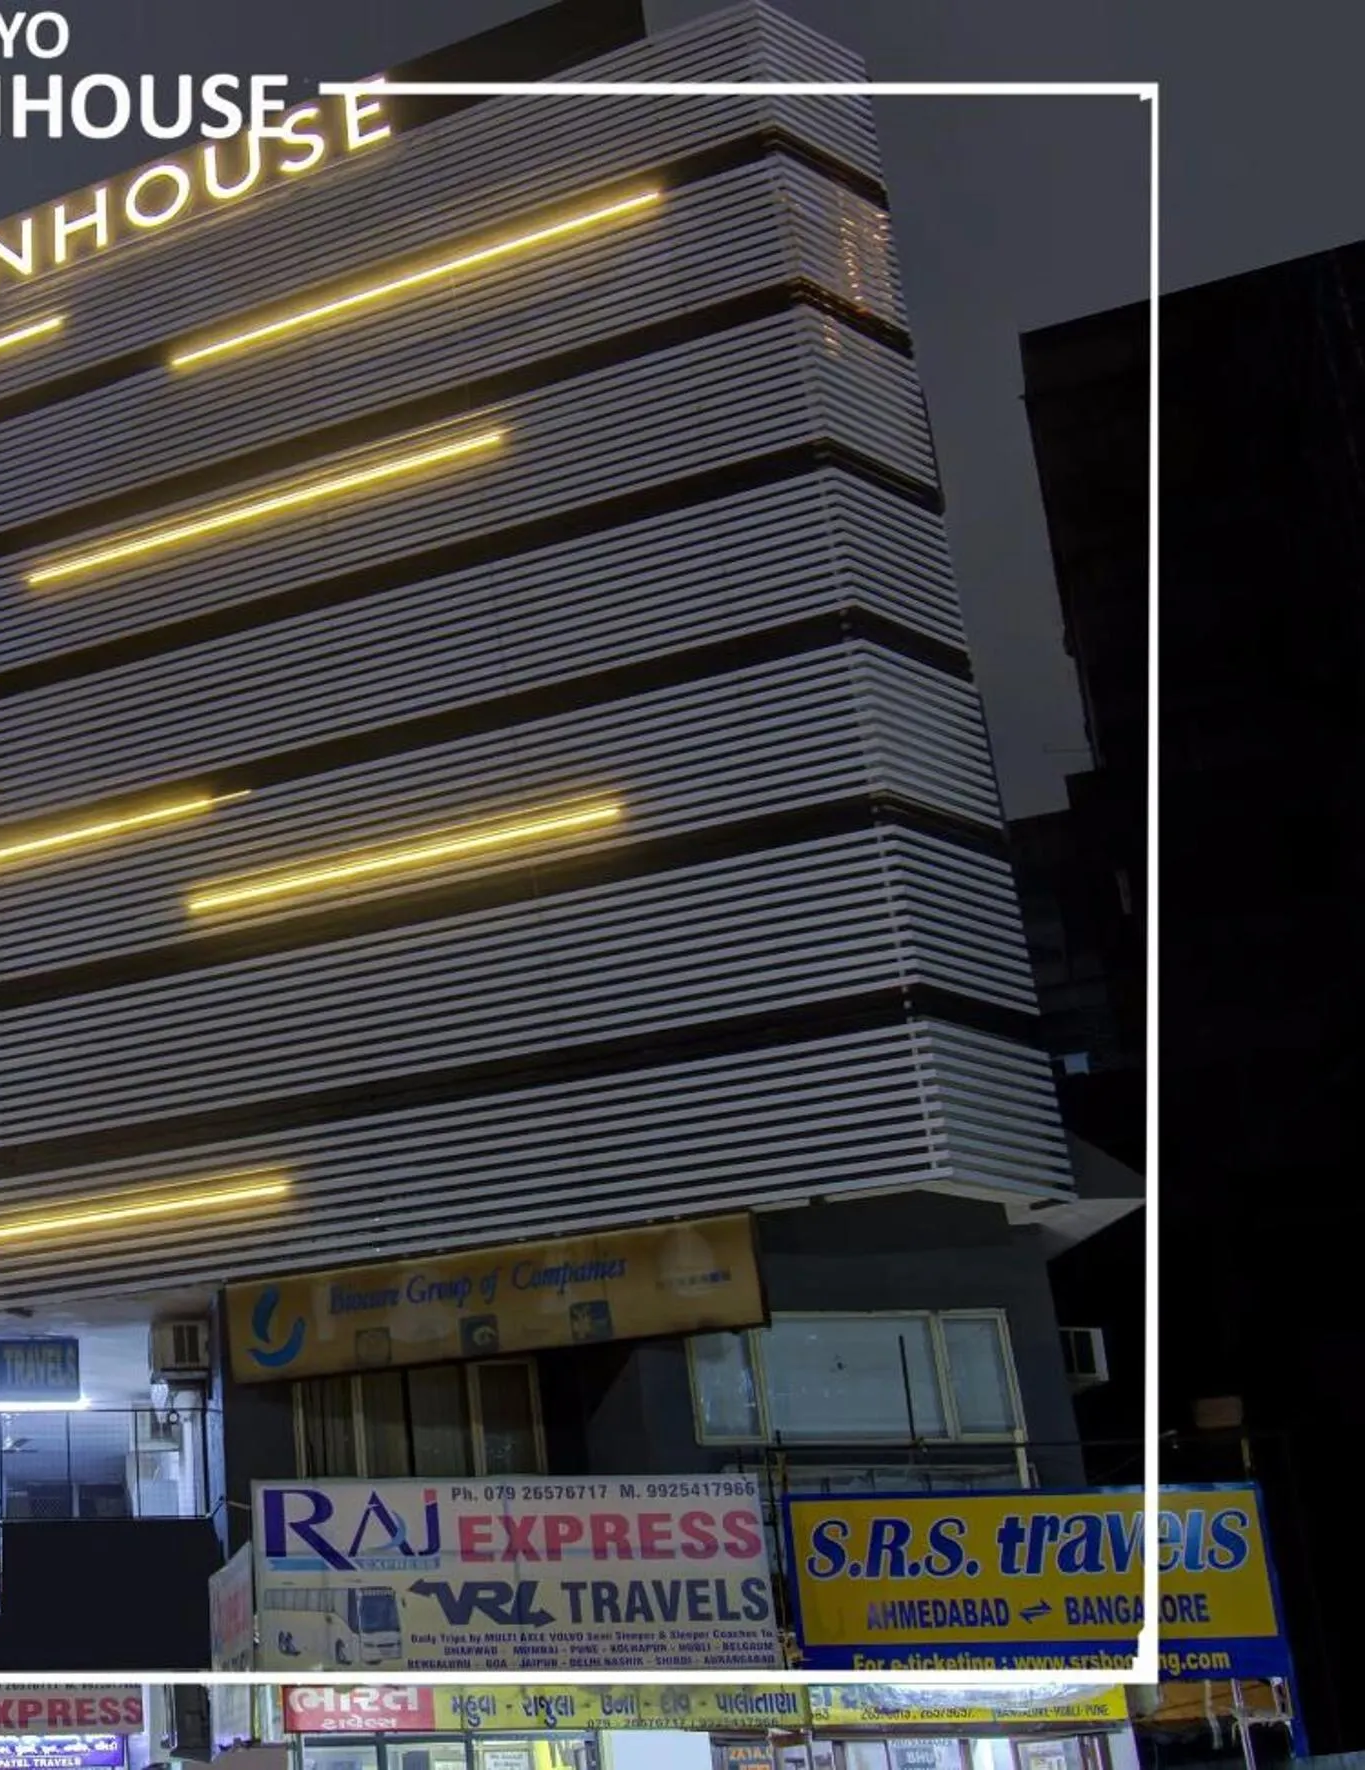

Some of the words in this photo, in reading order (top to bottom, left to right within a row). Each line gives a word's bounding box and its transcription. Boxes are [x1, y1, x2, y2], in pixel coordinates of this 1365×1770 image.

[451, 1486, 478, 1501] Ph.
[484, 1486, 516, 1500] 079
[620, 1484, 640, 1499] M.
[458, 1510, 762, 1562] EXPRESS
[806, 1516, 981, 1582] S.R.S.
[996, 1508, 1251, 1578] travels
[560, 1576, 770, 1625] TRAVELS
[867, 1598, 1010, 1631] AHMEDABAD
[1064, 1593, 1211, 1626] BANGAORE
[549, 1632, 583, 1642] VOLVO
